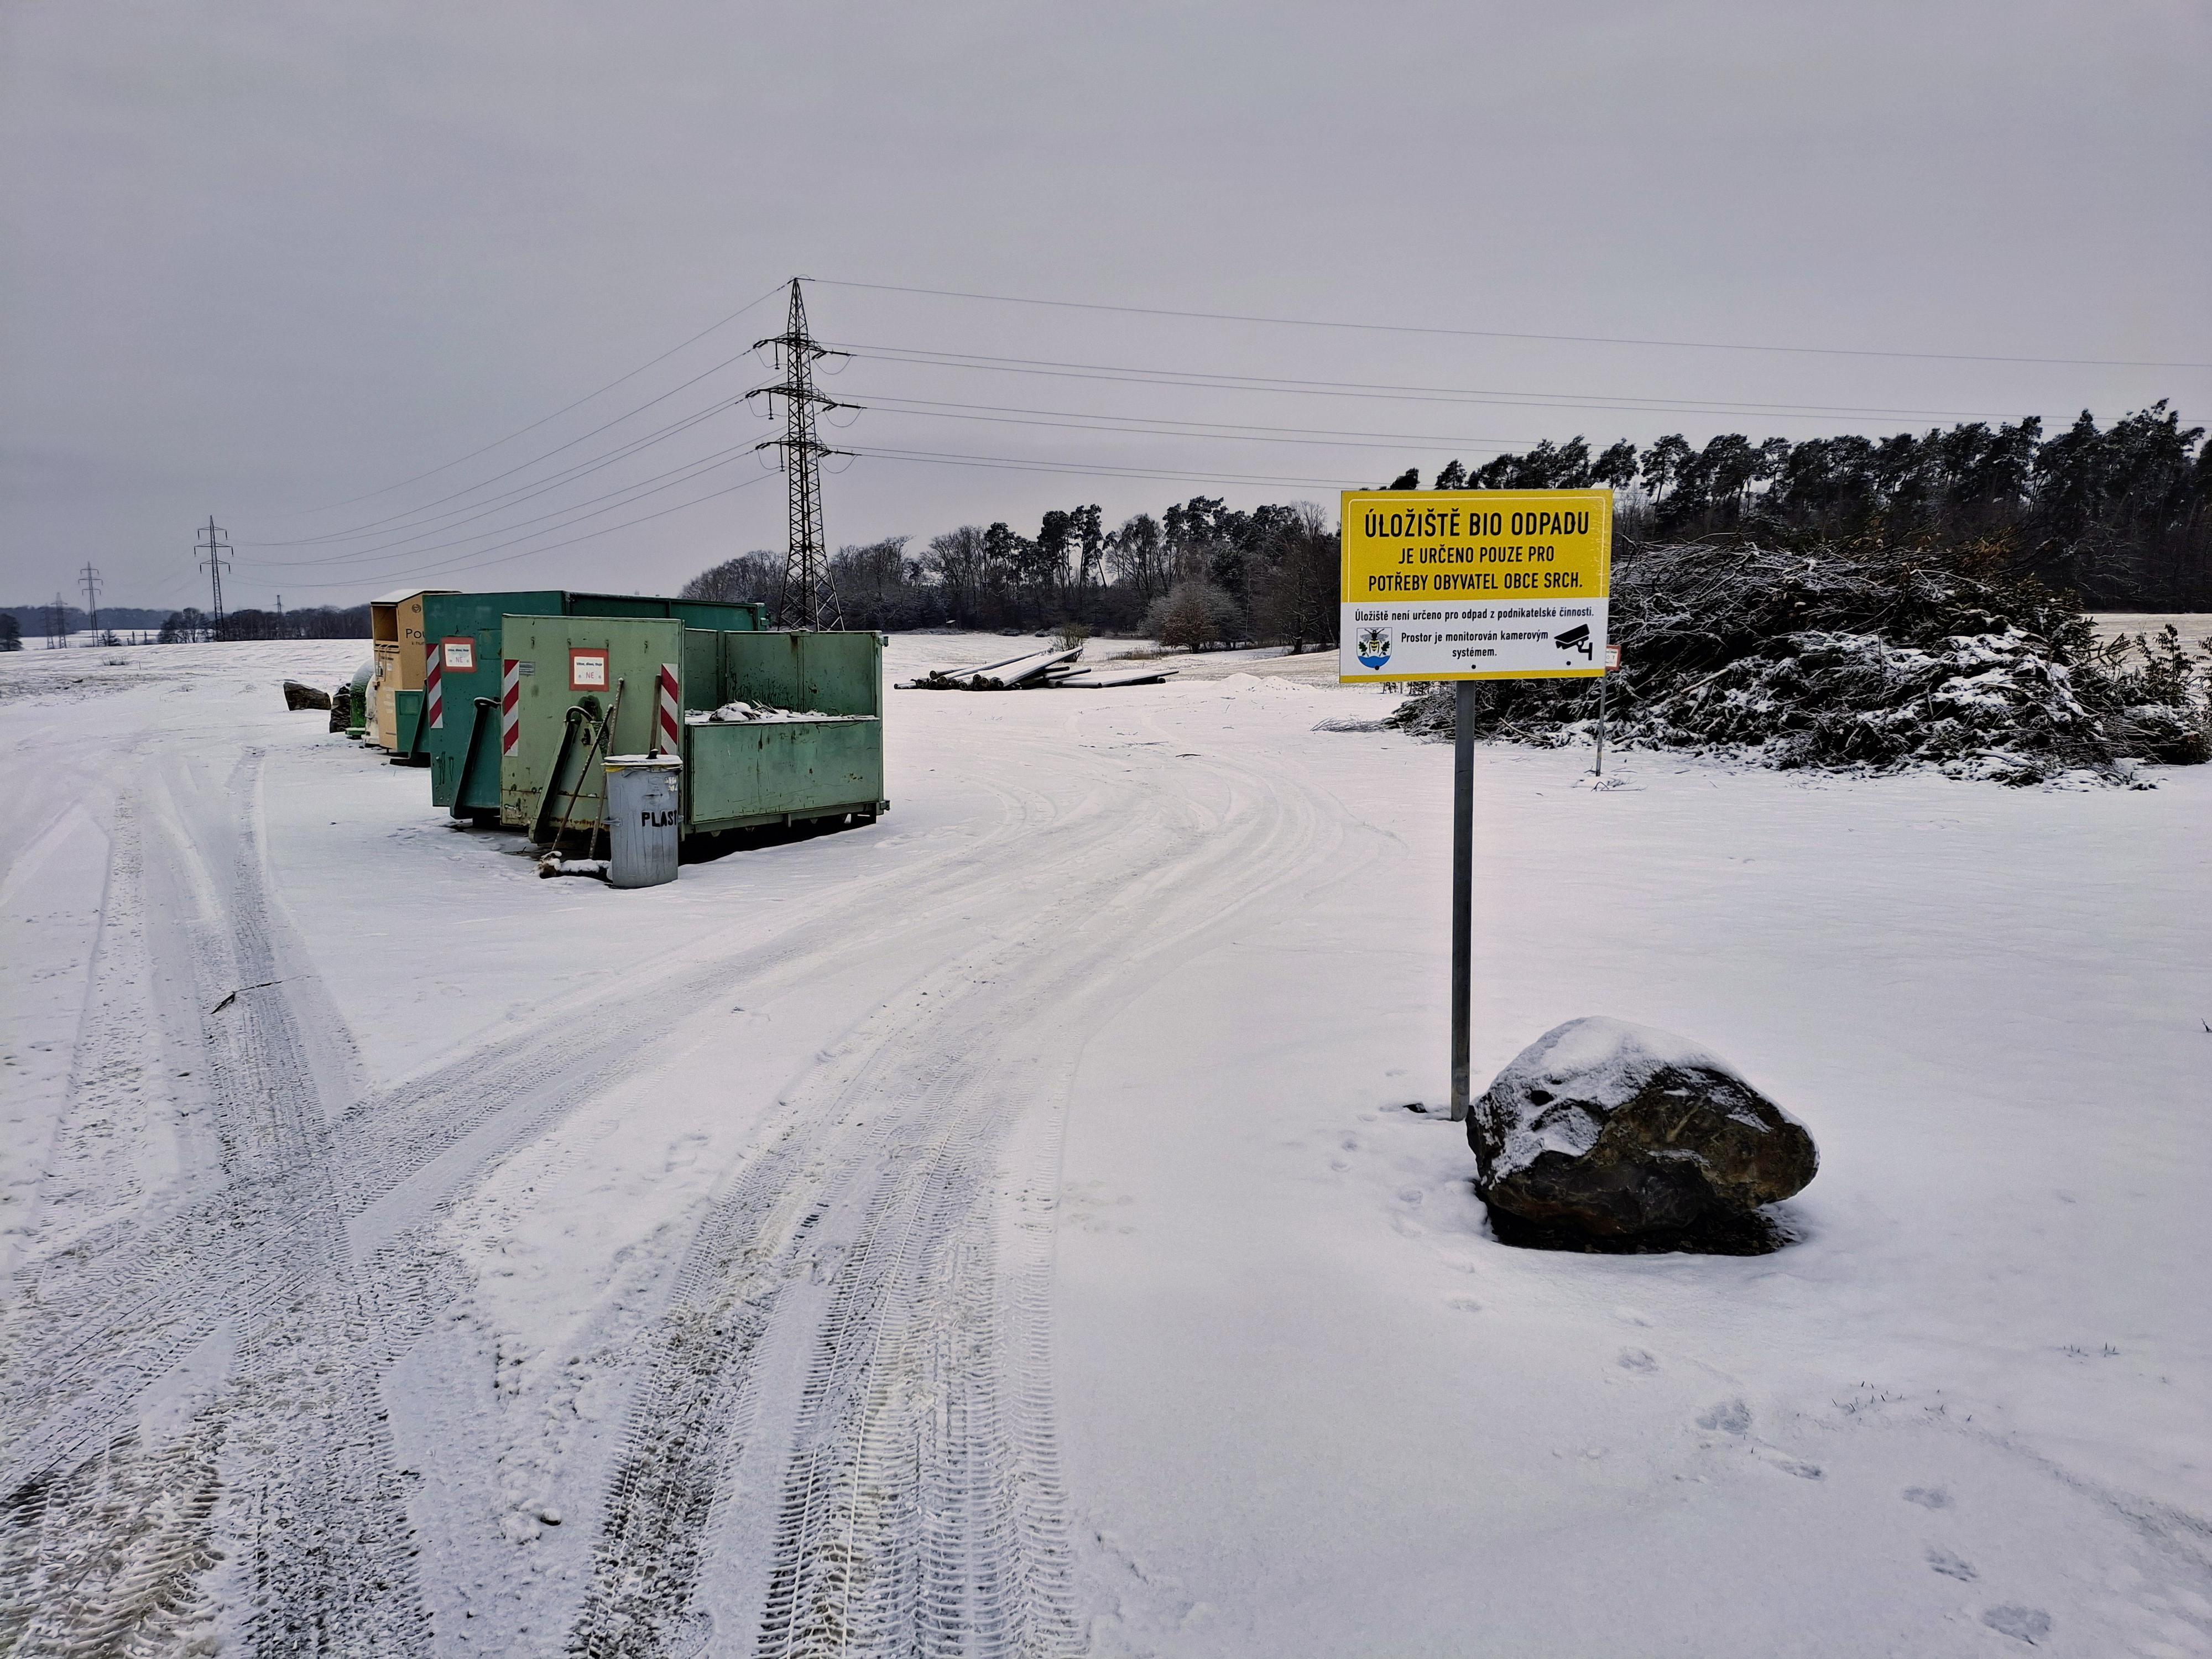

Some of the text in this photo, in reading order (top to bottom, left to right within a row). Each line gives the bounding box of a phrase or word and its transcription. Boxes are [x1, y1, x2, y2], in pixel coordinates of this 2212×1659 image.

[1365, 508, 1589, 538] ÚLOŽIŠTĚ BIO ODPADU
[1398, 544, 1554, 564] JE URČENO POUZE PRO
[1369, 571, 1583, 592] POTŘEBY OBYVATEL OBCE SRCH.
[1355, 608, 1389, 621] Úložiště
[1391, 609, 1410, 620] není
[1413, 609, 1442, 620] určeno
[1445, 611, 1458, 622] pro
[1462, 608, 1488, 622] odpad
[1498, 607, 1557, 621] podnikatelské
[1401, 629, 1548, 644] Prostor je monitorován kamerovým
[1452, 647, 1497, 660] systémem.
